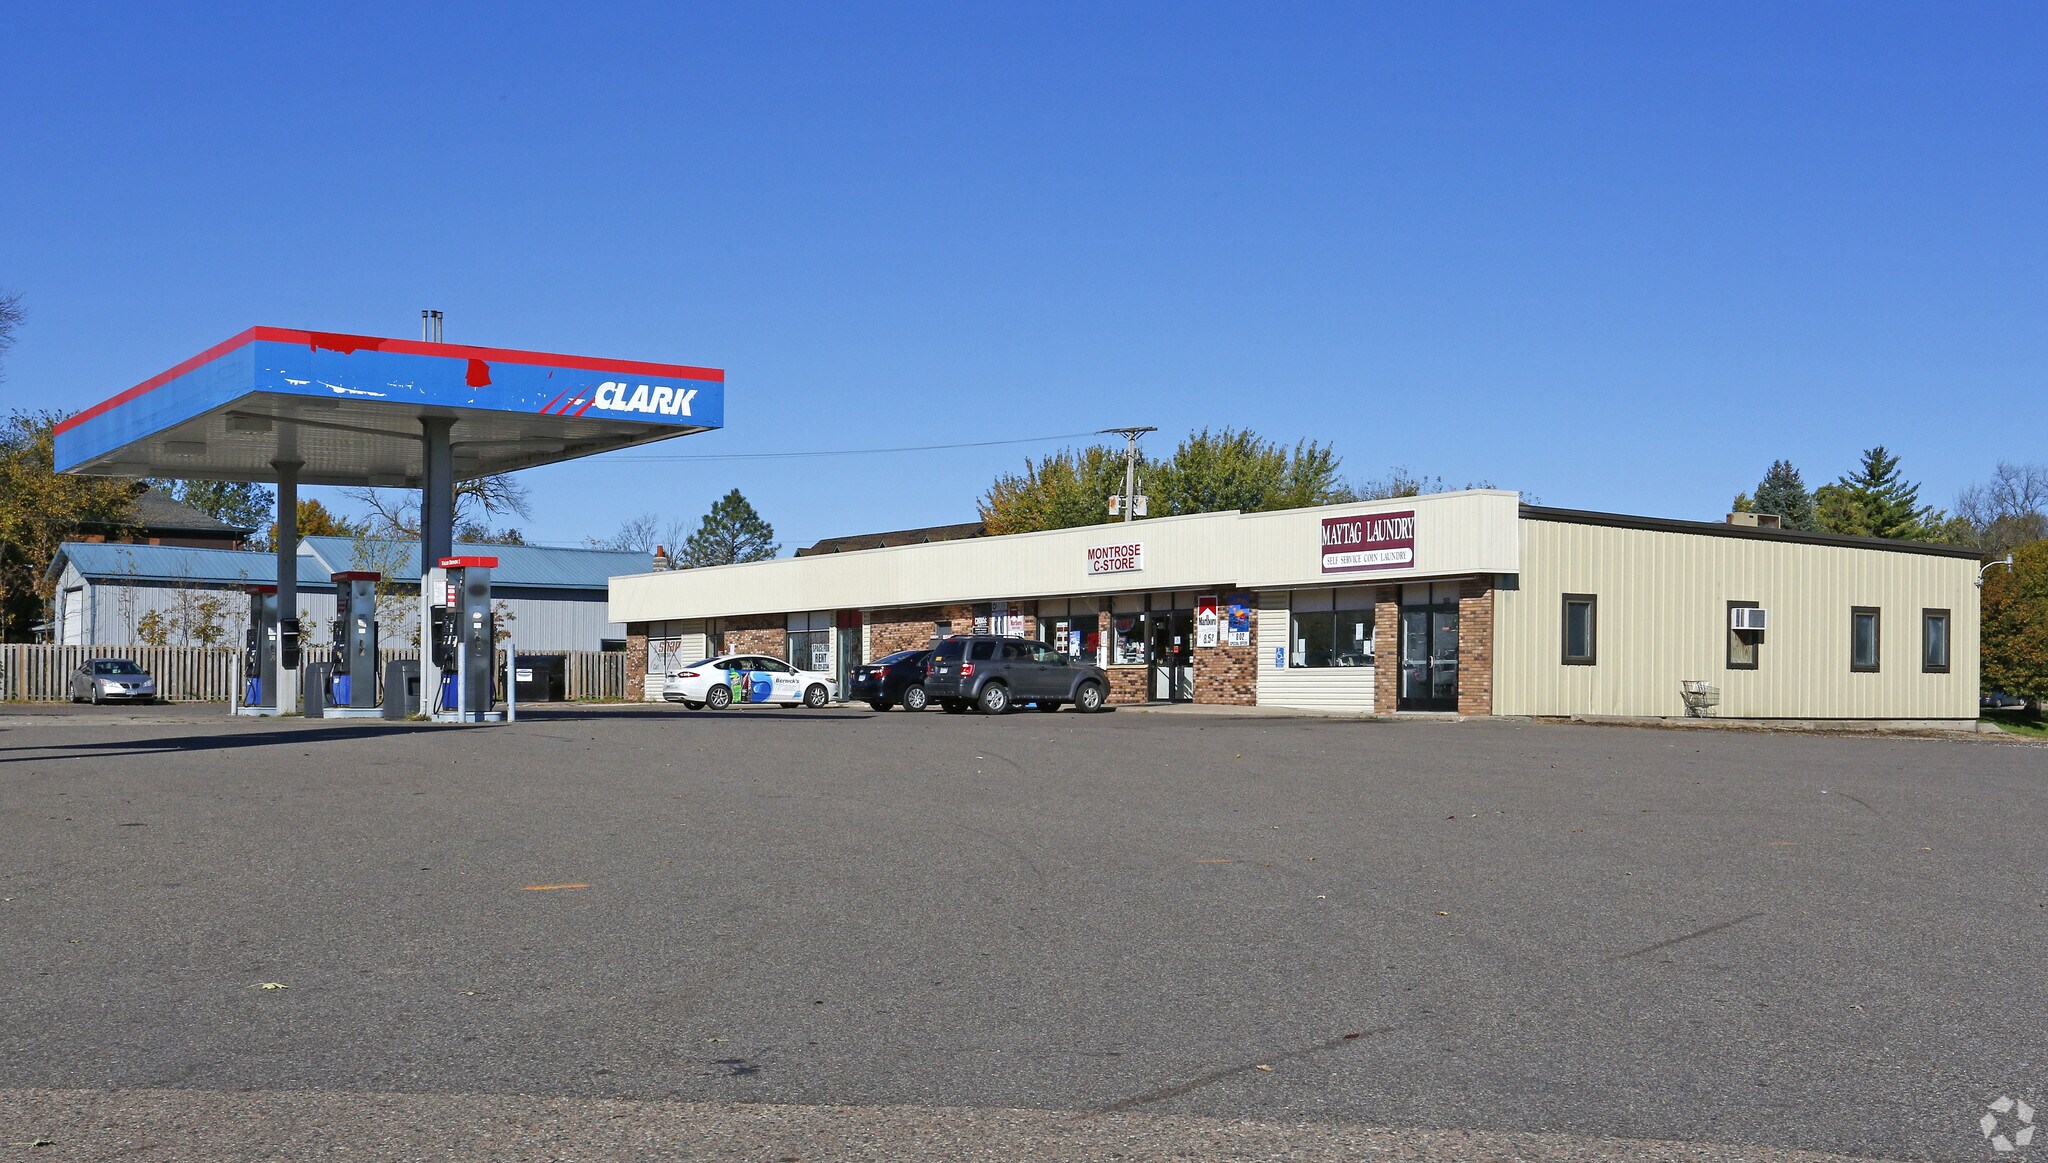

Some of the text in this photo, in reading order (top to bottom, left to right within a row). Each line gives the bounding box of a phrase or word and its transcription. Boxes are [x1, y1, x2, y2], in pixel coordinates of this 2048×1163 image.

[595, 381, 698, 417] CLARK
[1322, 517, 1414, 546] MAYTAG LAUNDRY
[1088, 544, 1141, 560] MONTROSE
[1327, 551, 1407, 565] SELF SERVICE COIN LAUNDRY
[1093, 557, 1135, 571] C-STORE
[1198, 617, 1217, 625] Marlboro
[815, 653, 827, 663] RENT
